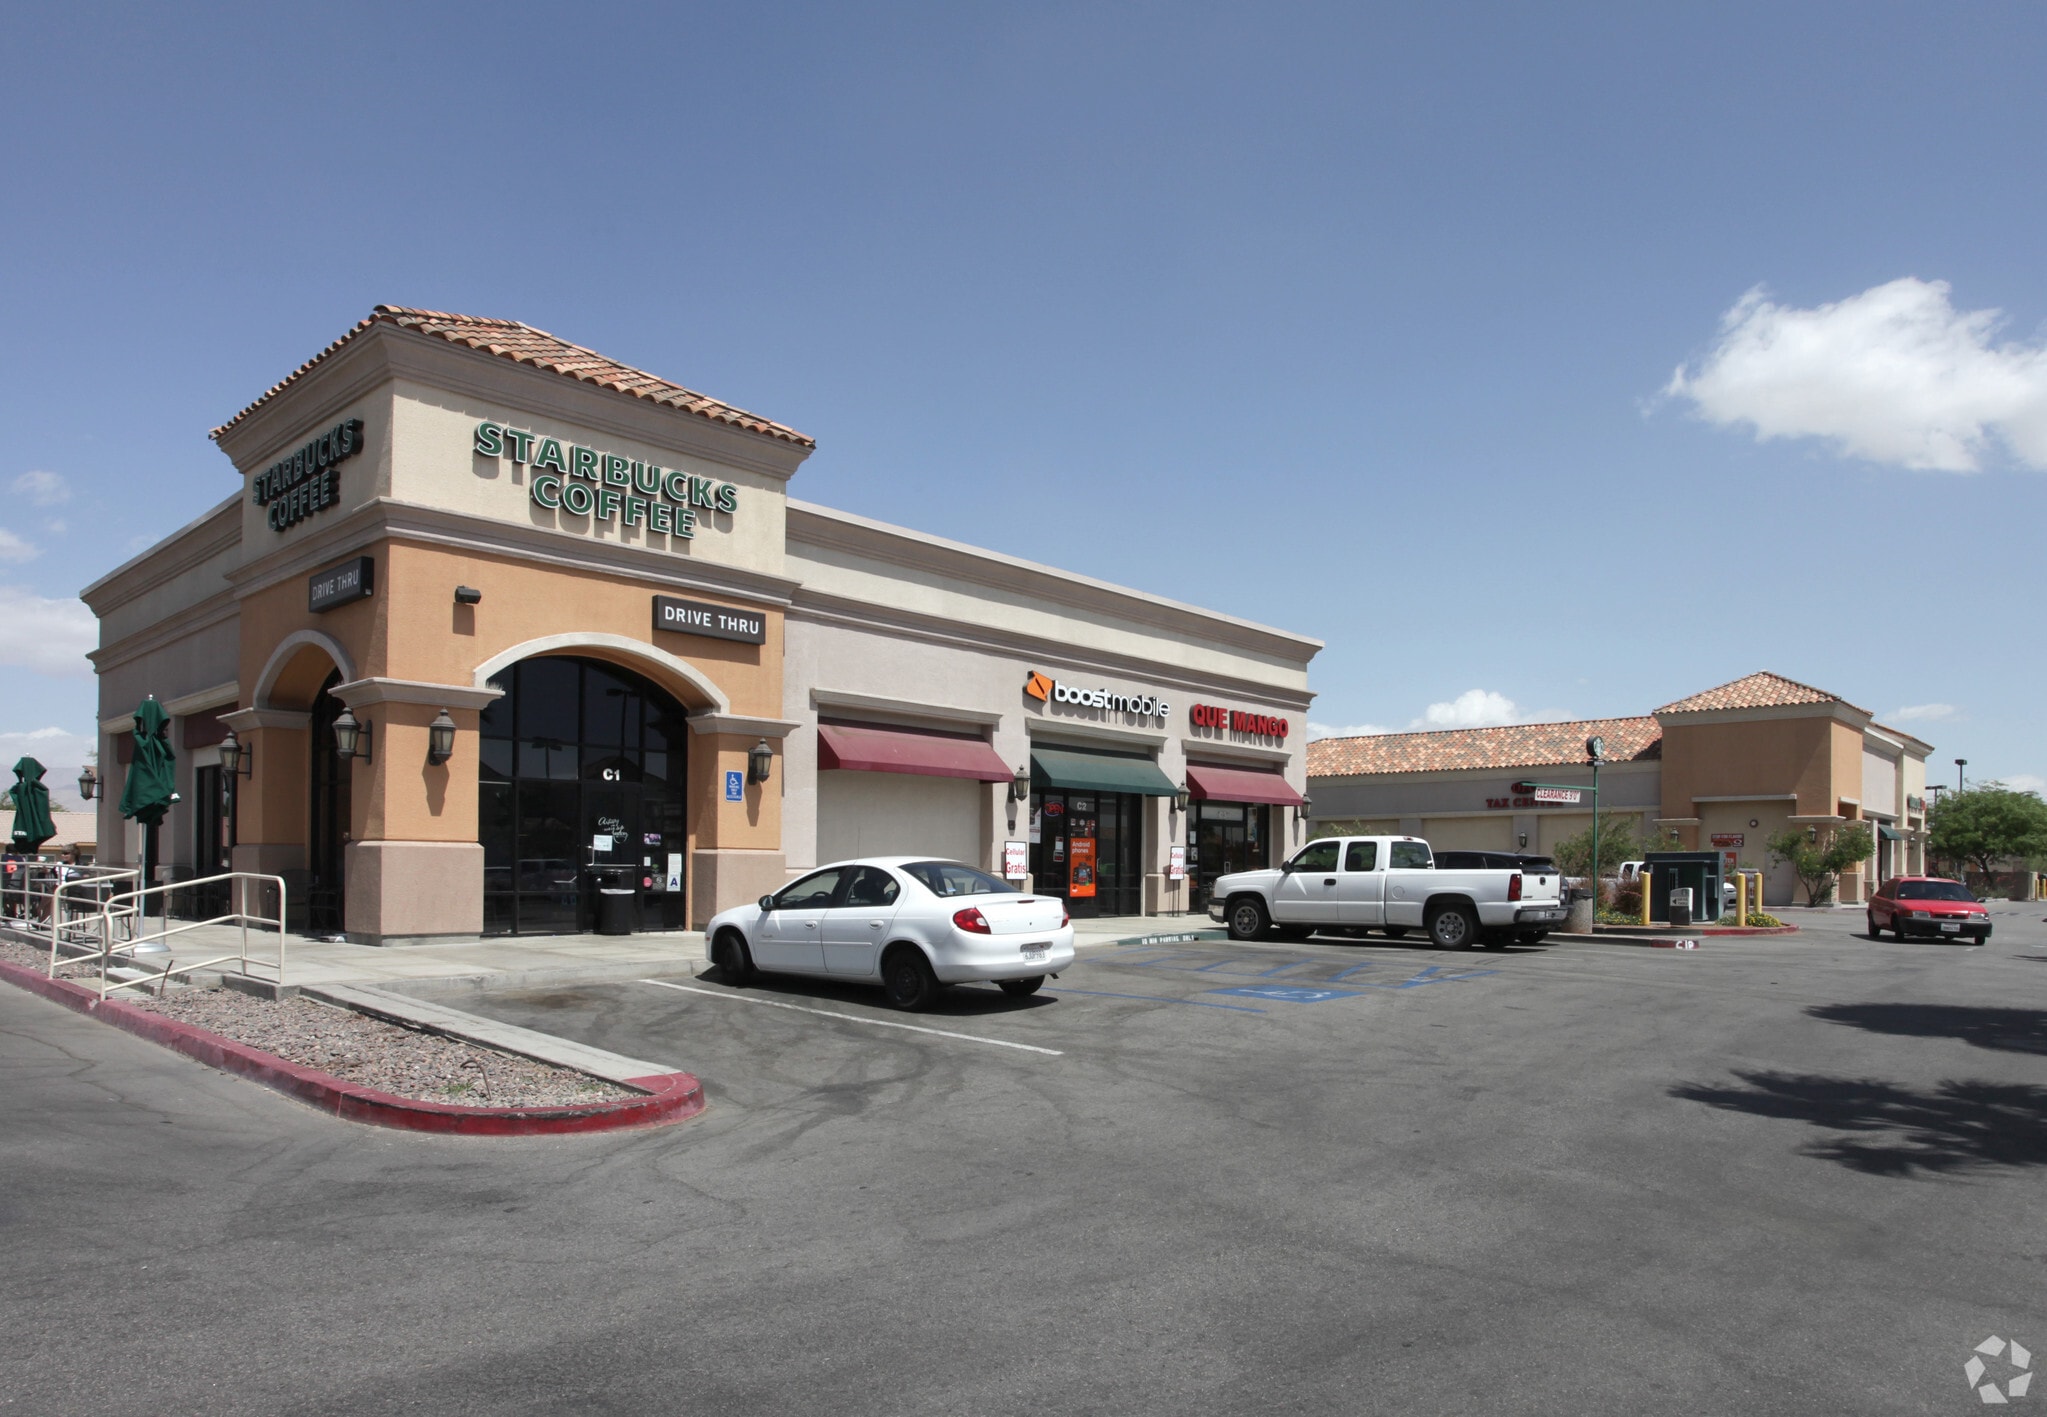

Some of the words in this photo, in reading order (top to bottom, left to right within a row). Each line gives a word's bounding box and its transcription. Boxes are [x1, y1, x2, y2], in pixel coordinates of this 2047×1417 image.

[253, 418, 360, 505] STARBUCKS
[475, 421, 738, 514] STARBUCKS
[268, 469, 337, 532] COFFEE
[531, 475, 695, 539] COFFEE
[312, 579, 335, 601] DRIVE
[337, 569, 360, 591] THRU
[664, 605, 712, 627] DRIVE
[718, 614, 759, 635] THRU
[1192, 703, 1228, 729] QUE
[1233, 711, 1289, 738] MANGO
[602, 768, 620, 781] C1
[1486, 797, 1509, 808] TAX
[1536, 788, 1569, 800] CLEARANCE
[1076, 801, 1087, 811] C2
[1005, 848, 1024, 856] Cellular
[1005, 861, 1026, 874] Gratis
[670, 877, 678, 886] A
